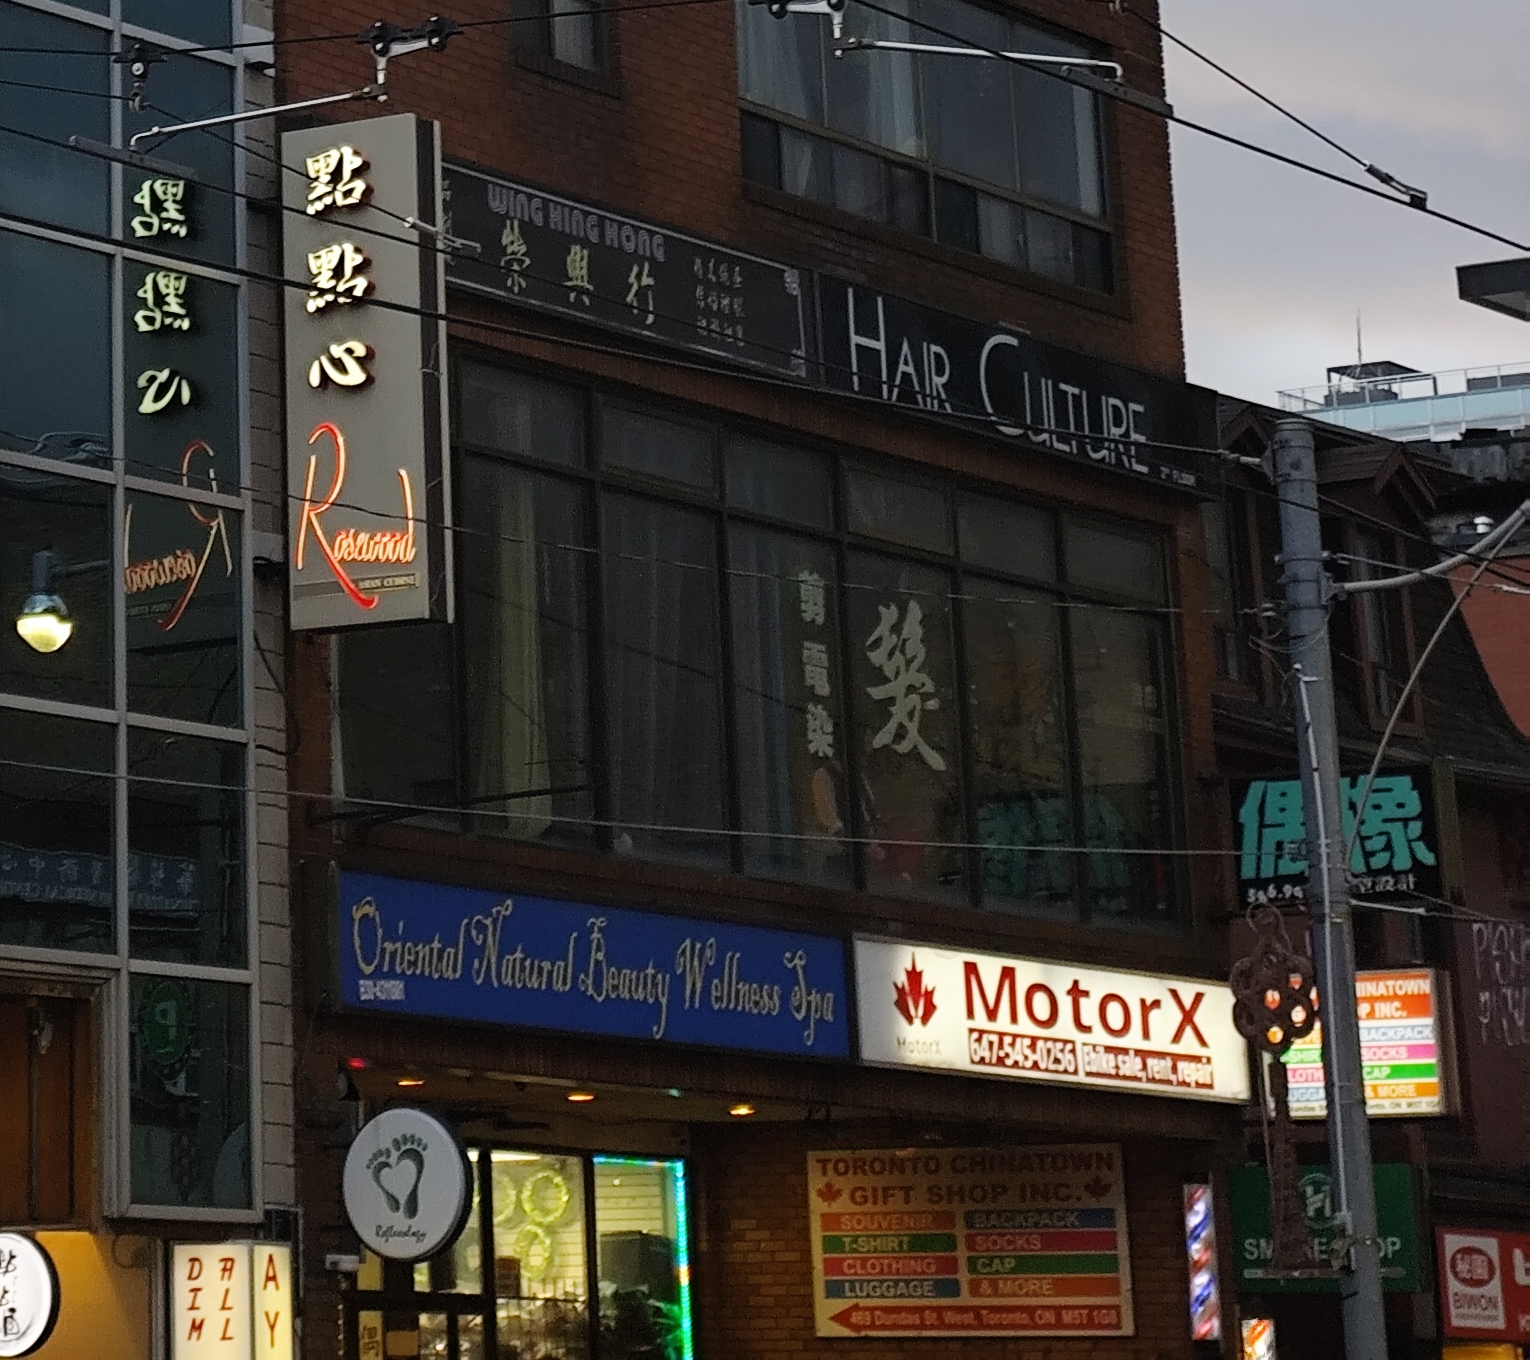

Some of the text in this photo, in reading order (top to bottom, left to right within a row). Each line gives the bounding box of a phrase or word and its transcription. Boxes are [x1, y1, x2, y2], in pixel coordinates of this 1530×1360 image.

[487, 183, 544, 227] WING
[549, 201, 600, 244] HING
[605, 219, 665, 262] HONG
[305, 146, 369, 388] 點點心
[295, 421, 418, 609] Rosewood
[352, 896, 835, 1047] Oriental Natural Beauty Wellness Spa
[962, 960, 1210, 1049] MotorX
[969, 1032, 1076, 1073] 647-545-0256
[816, 1153, 1113, 1176] TORONTO CHINATOWN
[850, 1186, 915, 1206] GIFT
[926, 1183, 1008, 1205] SHOP
[842, 1235, 910, 1252] T-SHIRT
[974, 1233, 1042, 1251] SOCKS
[842, 1259, 937, 1275] CLOTHING
[976, 1257, 1016, 1274] CAP
[845, 1280, 935, 1298] LUGGAGE
